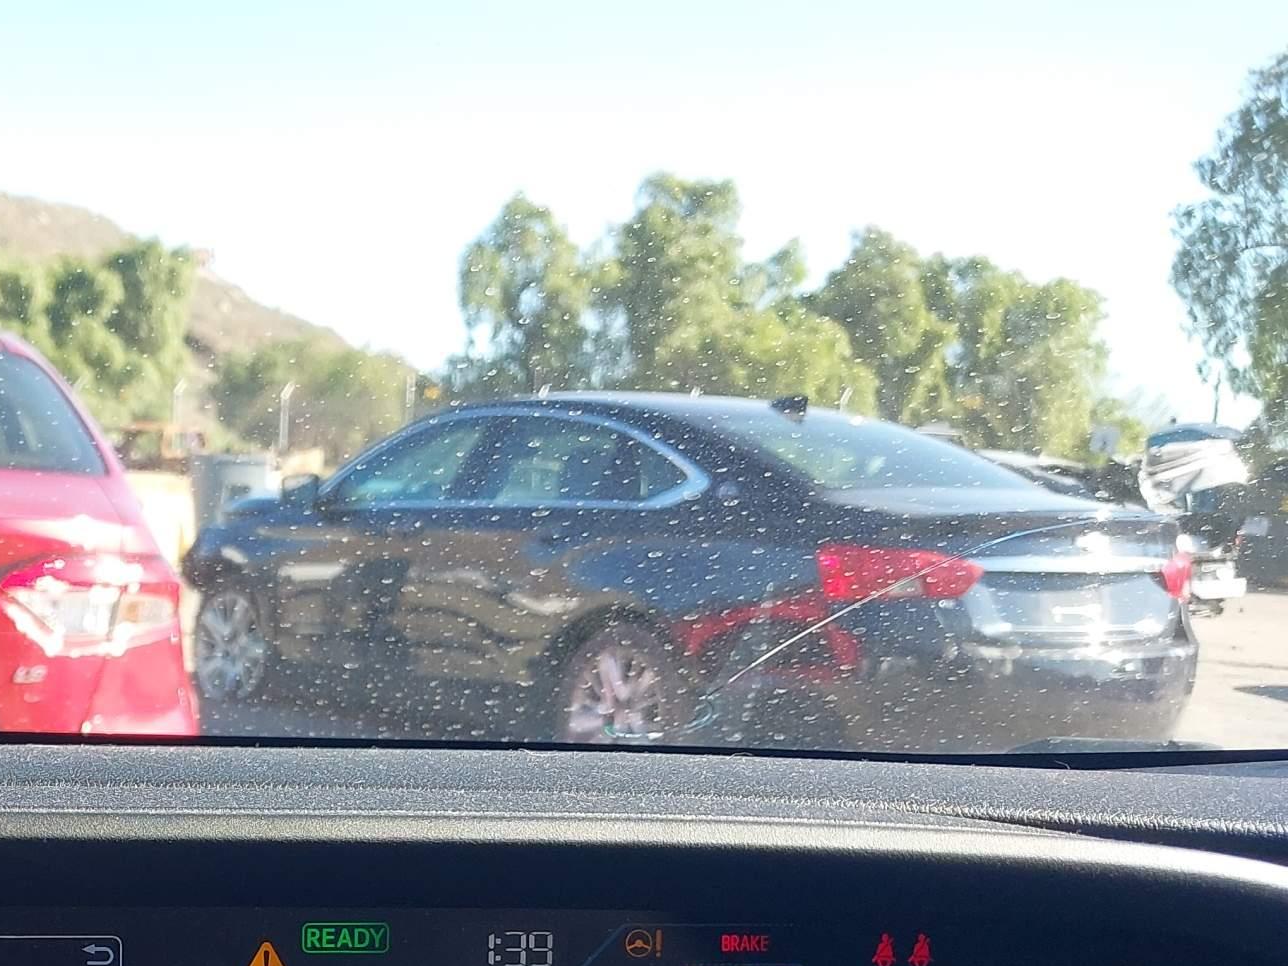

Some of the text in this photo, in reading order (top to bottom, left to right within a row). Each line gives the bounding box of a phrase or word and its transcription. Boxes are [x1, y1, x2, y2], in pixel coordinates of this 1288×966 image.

[306, 928, 385, 948] READY
[721, 934, 770, 952] BRAKE
[489, 932, 553, 966] 1:39
